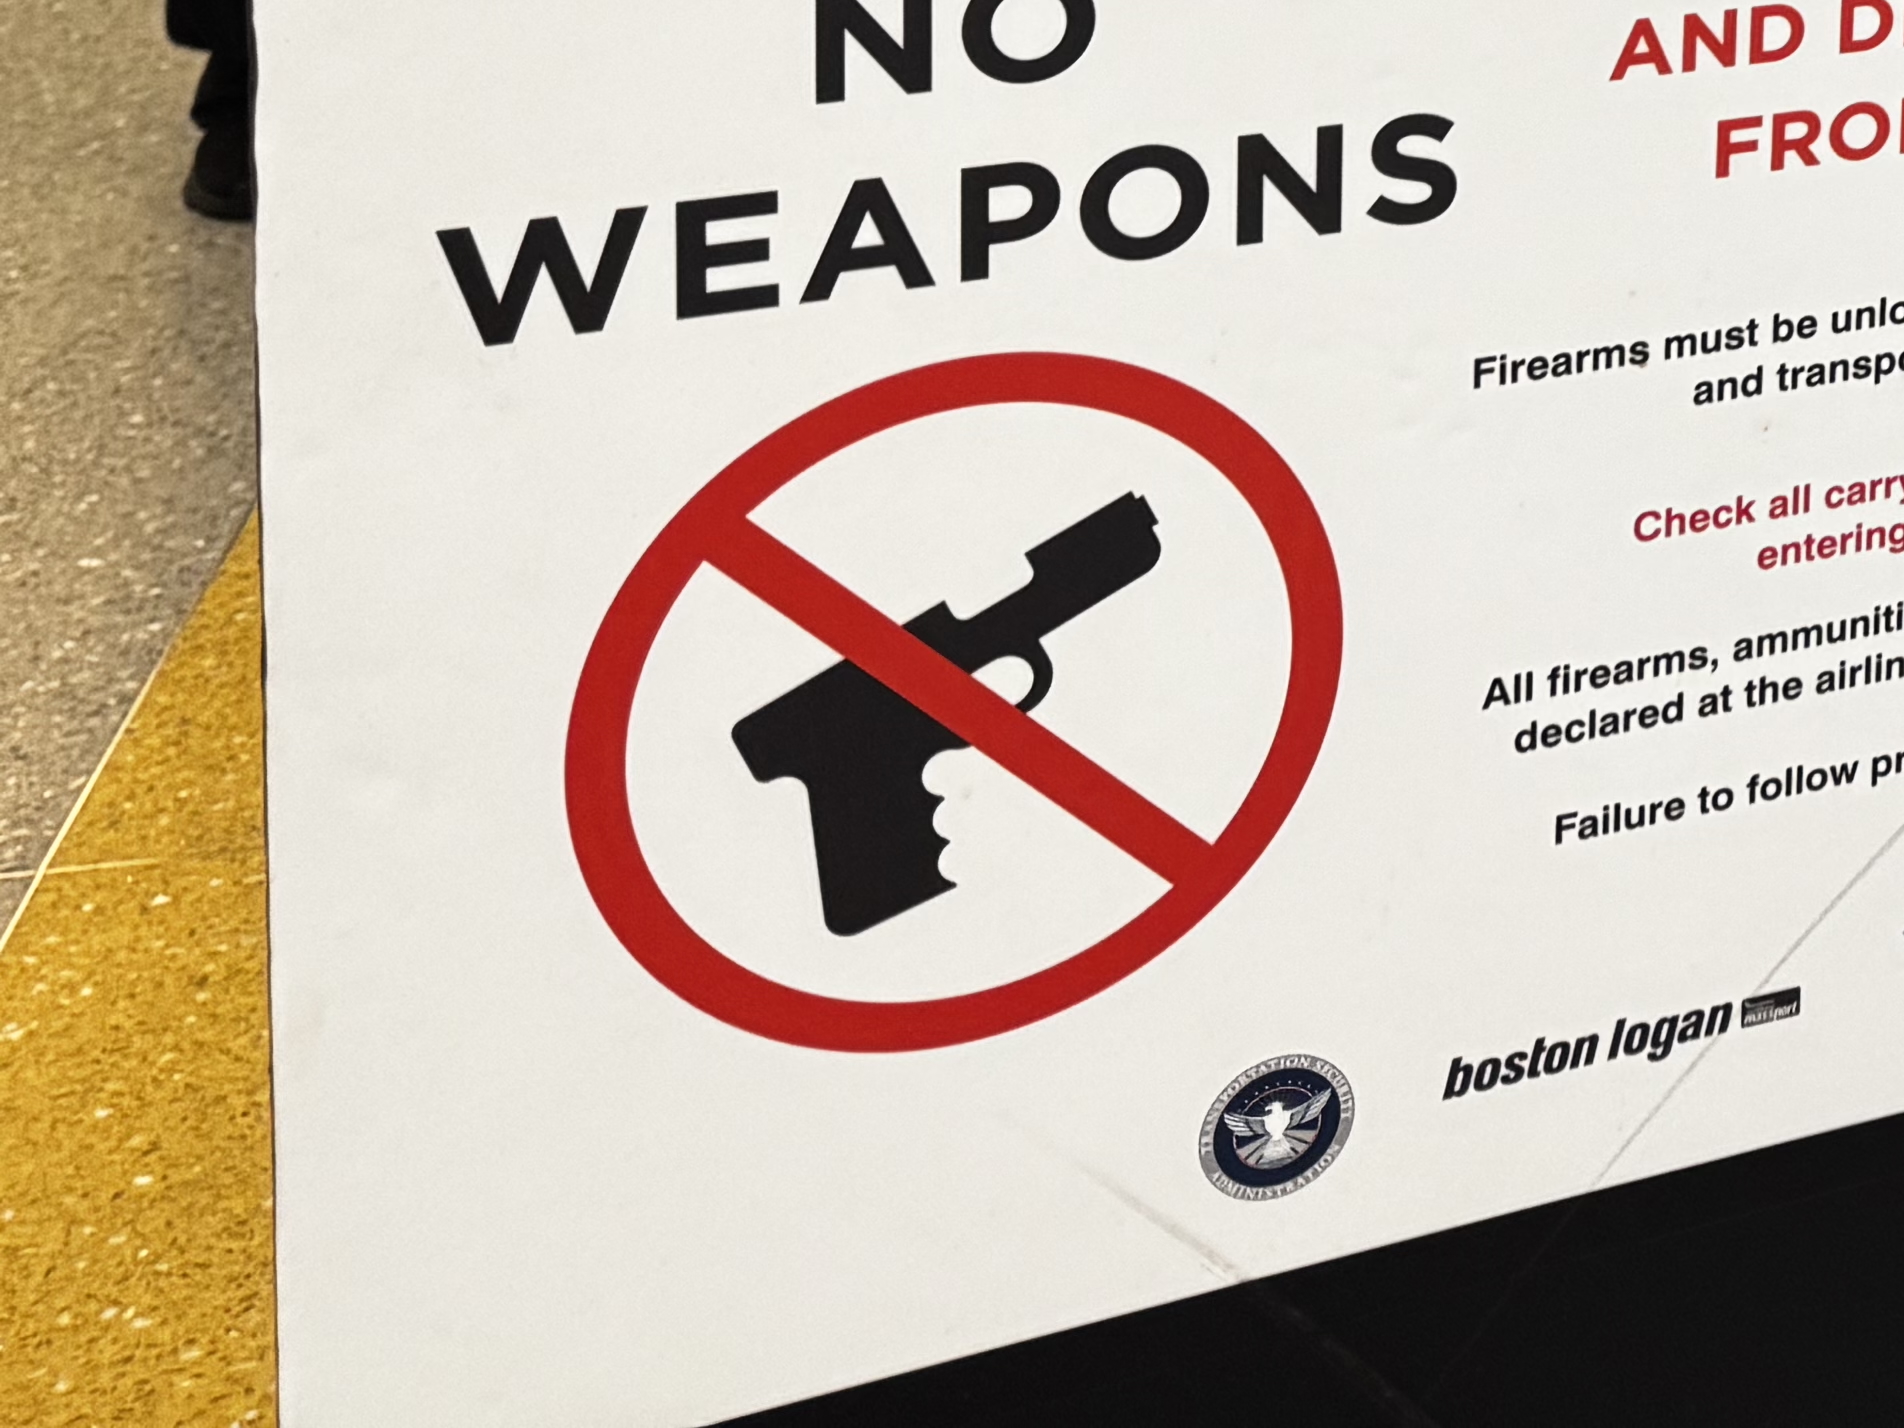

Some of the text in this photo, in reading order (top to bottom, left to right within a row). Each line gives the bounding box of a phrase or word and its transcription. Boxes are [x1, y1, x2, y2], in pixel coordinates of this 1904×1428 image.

[1610, 5, 1804, 80] AND
[436, 114, 1456, 346] WEAPONS
[1474, 341, 1649, 388] Firearms
[1665, 319, 1758, 360] must
[1773, 313, 1817, 343] be
[1694, 366, 1763, 405] and
[1634, 496, 1755, 541] Check
[1769, 484, 1810, 519] all
[1483, 672, 1533, 709] All
[1547, 647, 1718, 697] firearms,
[1515, 692, 1683, 753] declared
[1699, 685, 1732, 717] at
[1745, 676, 1802, 707] the
[1556, 798, 1685, 844] Failure
[1698, 787, 1733, 814] to
[1747, 761, 1858, 804] follow
[1443, 1002, 1733, 1101] boston logan
